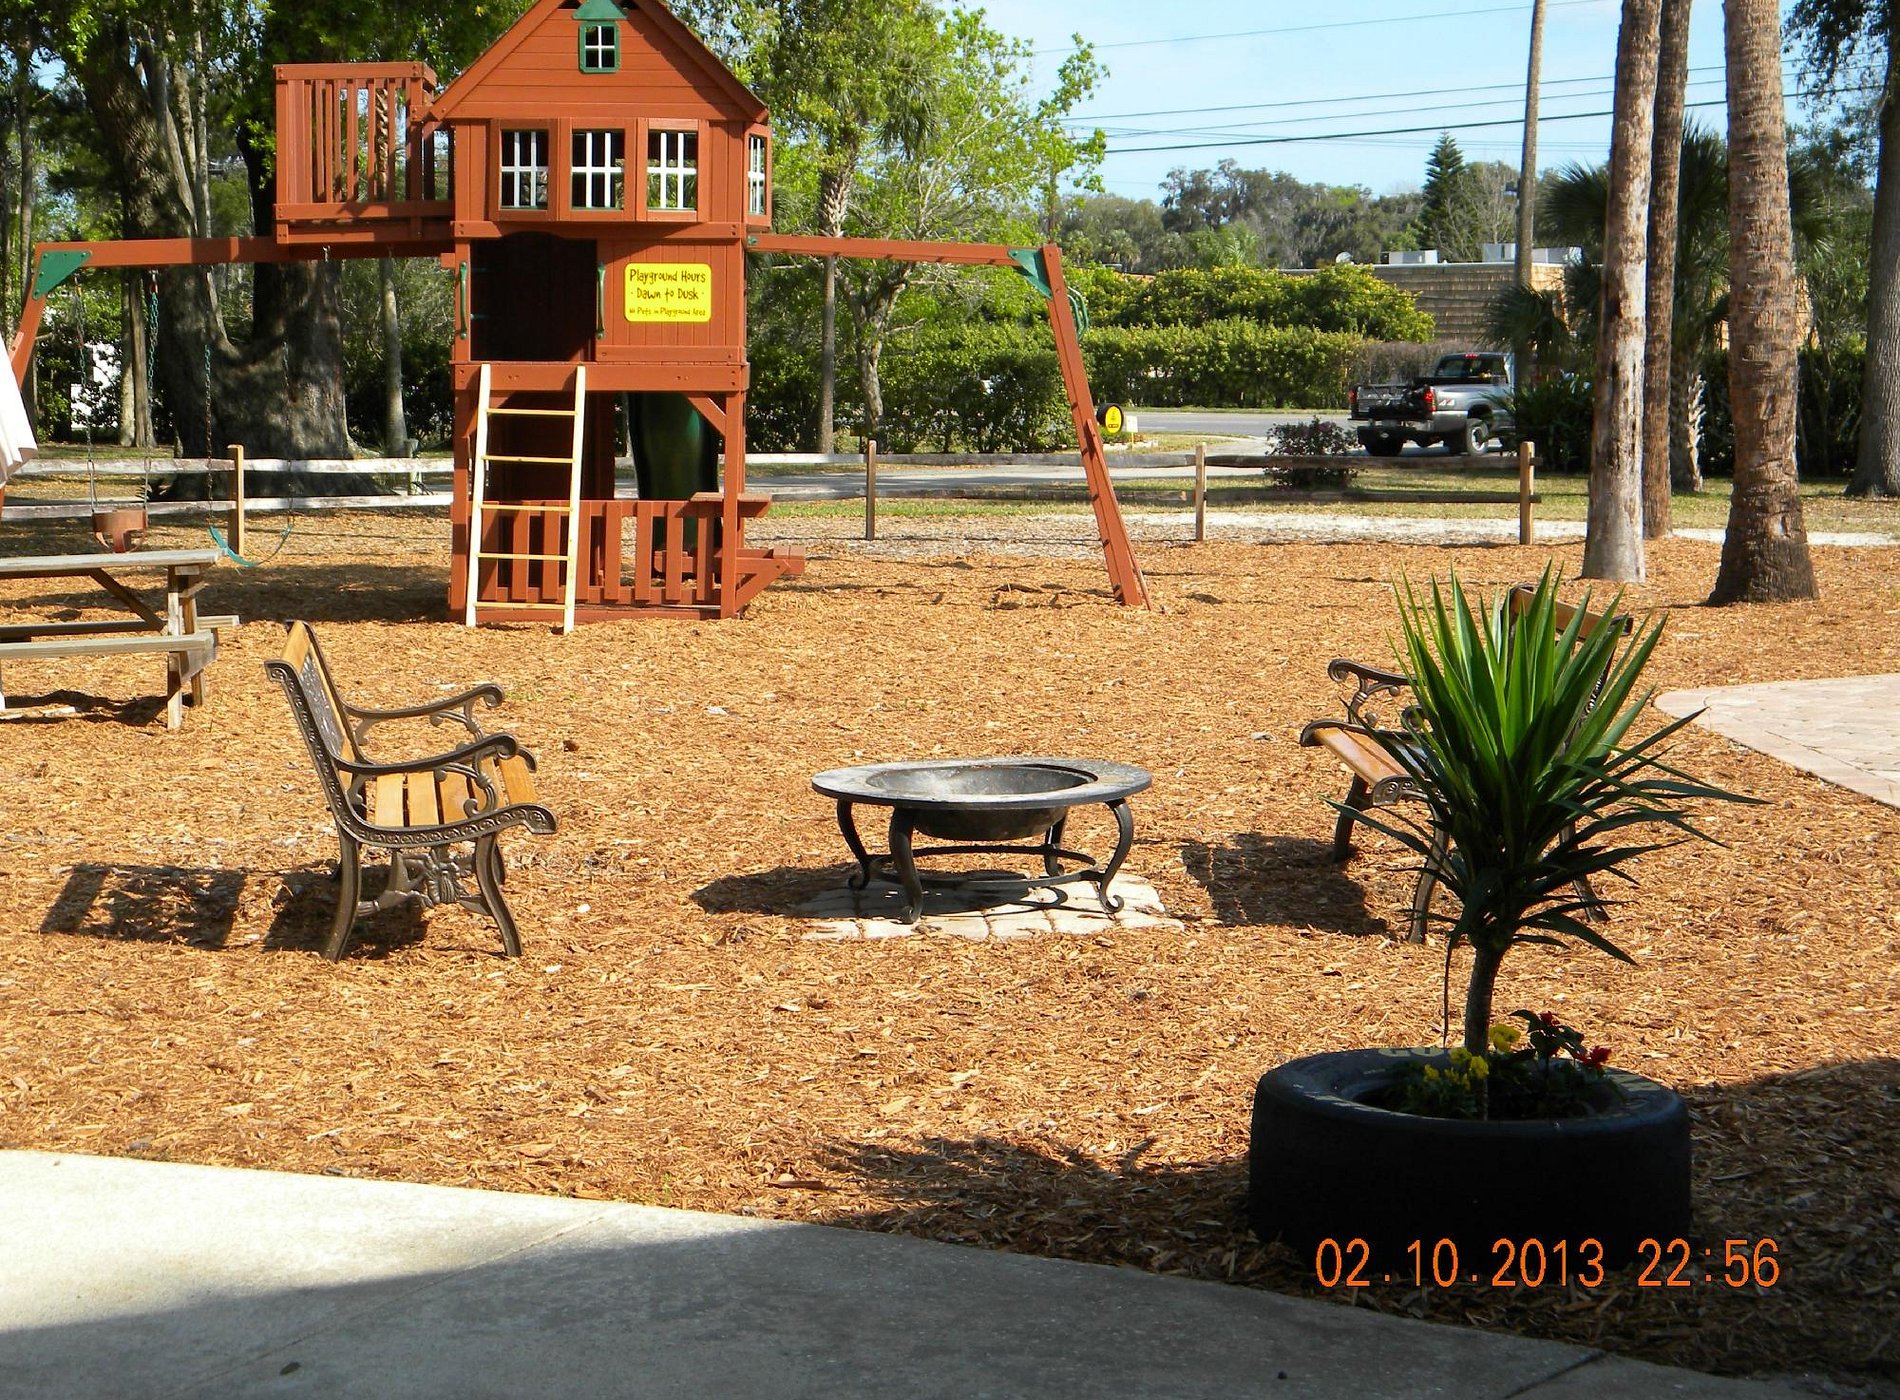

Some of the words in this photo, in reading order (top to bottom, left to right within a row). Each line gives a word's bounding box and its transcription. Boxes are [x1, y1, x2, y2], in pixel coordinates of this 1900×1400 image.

[629, 268, 678, 285] Playground
[681, 270, 706, 283] Hours
[636, 287, 661, 299] Dawn
[664, 287, 675, 303] to
[677, 287, 699, 300] Dusk
